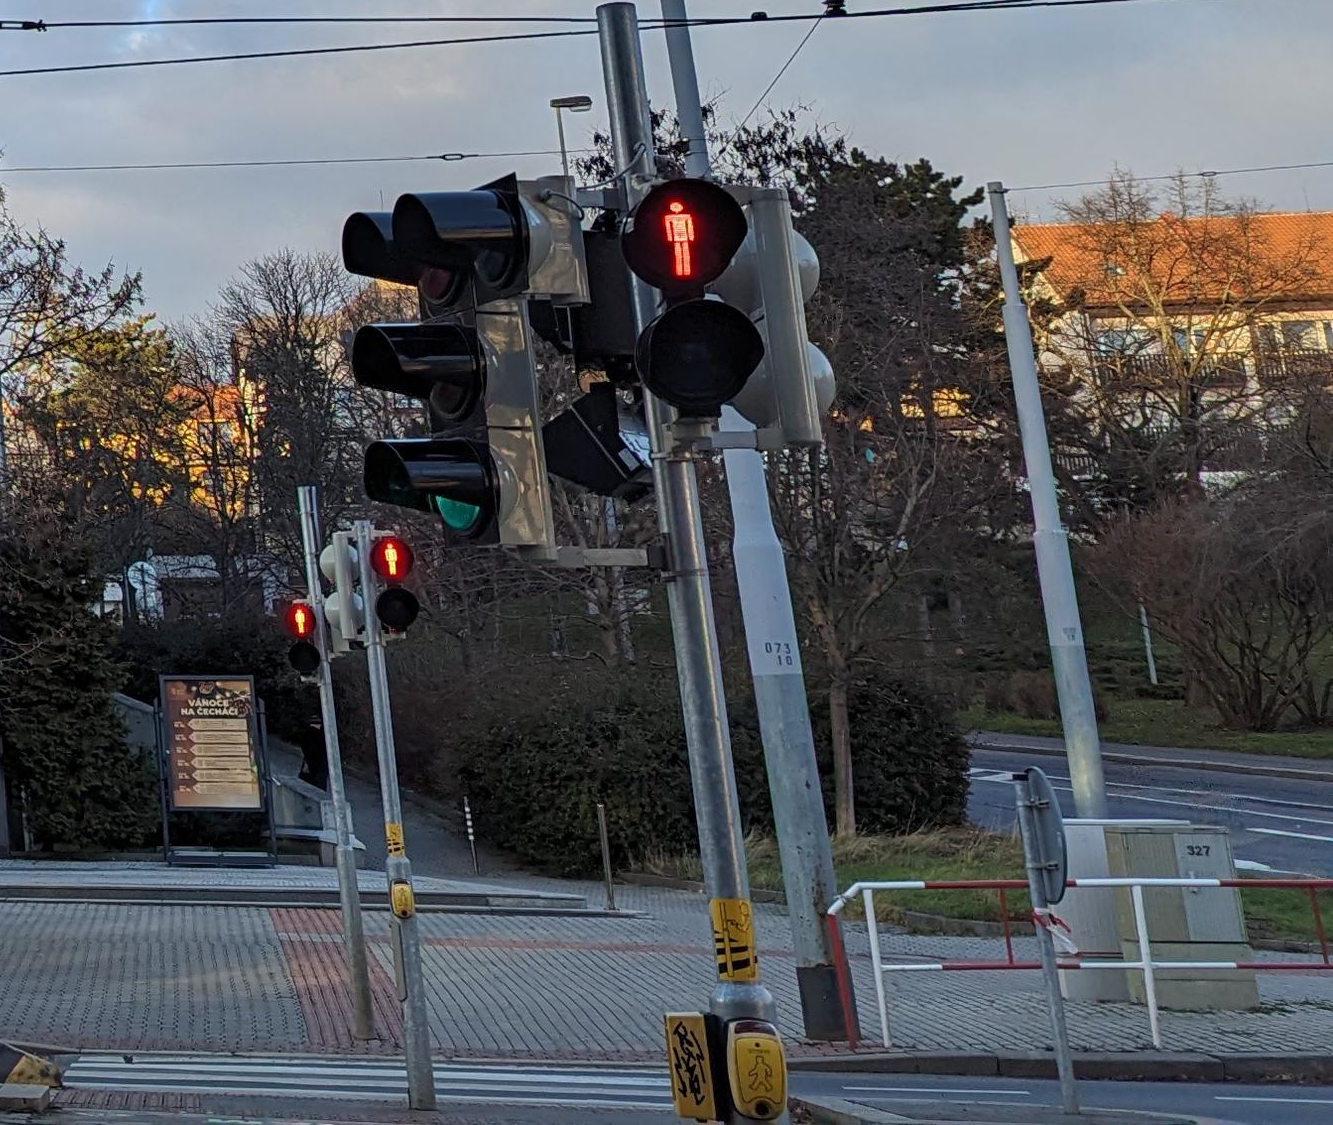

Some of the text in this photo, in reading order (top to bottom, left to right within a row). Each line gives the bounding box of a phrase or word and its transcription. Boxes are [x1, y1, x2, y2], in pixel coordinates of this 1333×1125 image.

[765, 642, 791, 654] 073
[777, 655, 792, 665] 10
[188, 698, 229, 707] VÁNOCE
[181, 707, 195, 716] NA
[1187, 845, 1210, 856] 327
